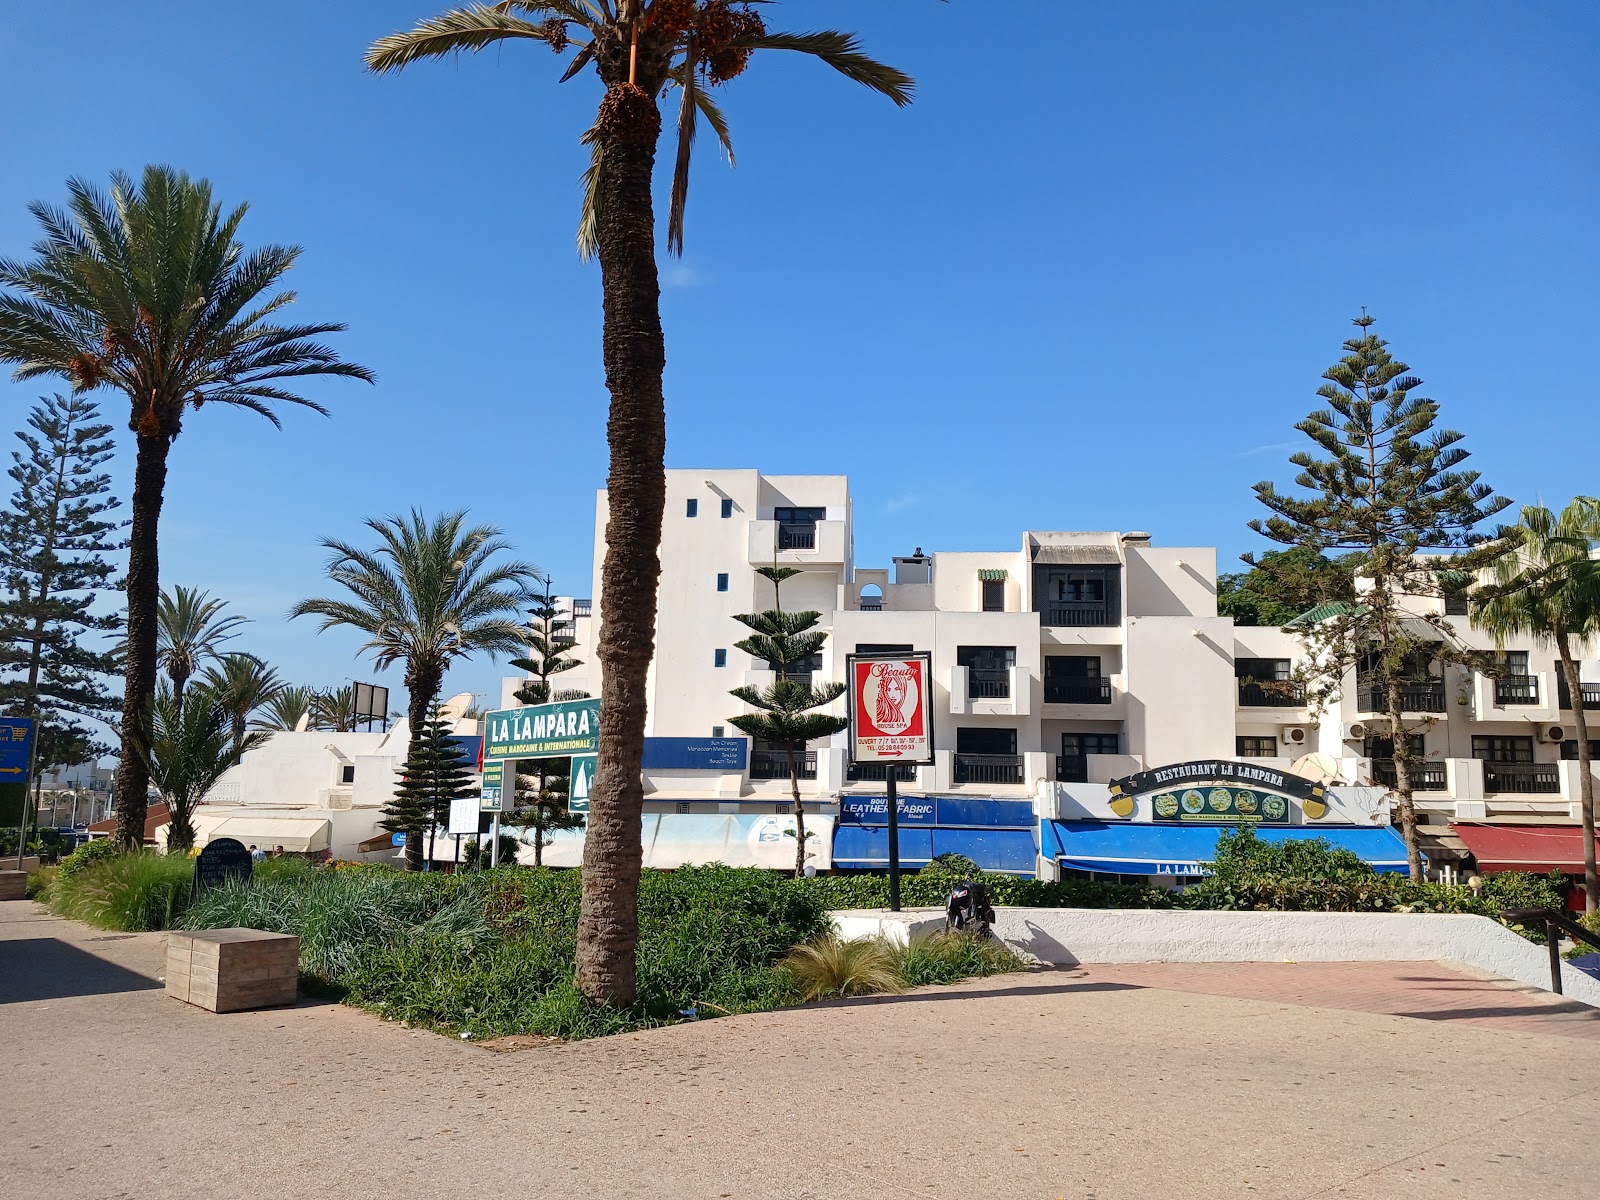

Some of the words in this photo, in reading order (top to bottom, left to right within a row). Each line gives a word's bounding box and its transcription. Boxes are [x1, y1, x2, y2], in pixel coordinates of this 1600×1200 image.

[872, 663, 918, 680] Beauty
[492, 719, 509, 742] LA
[514, 709, 590, 741] LAMPARA
[490, 746, 508, 755] CUISINE
[508, 744, 538, 753] MAROCAINE
[544, 739, 590, 750] INTERNATIONALE
[1154, 764, 1217, 783] RESTAURANT
[1221, 764, 1234, 775] LA
[1237, 766, 1284, 786] LAMPARA
[897, 805, 933, 814] FABRIC
[1156, 864, 1172, 874] LA
